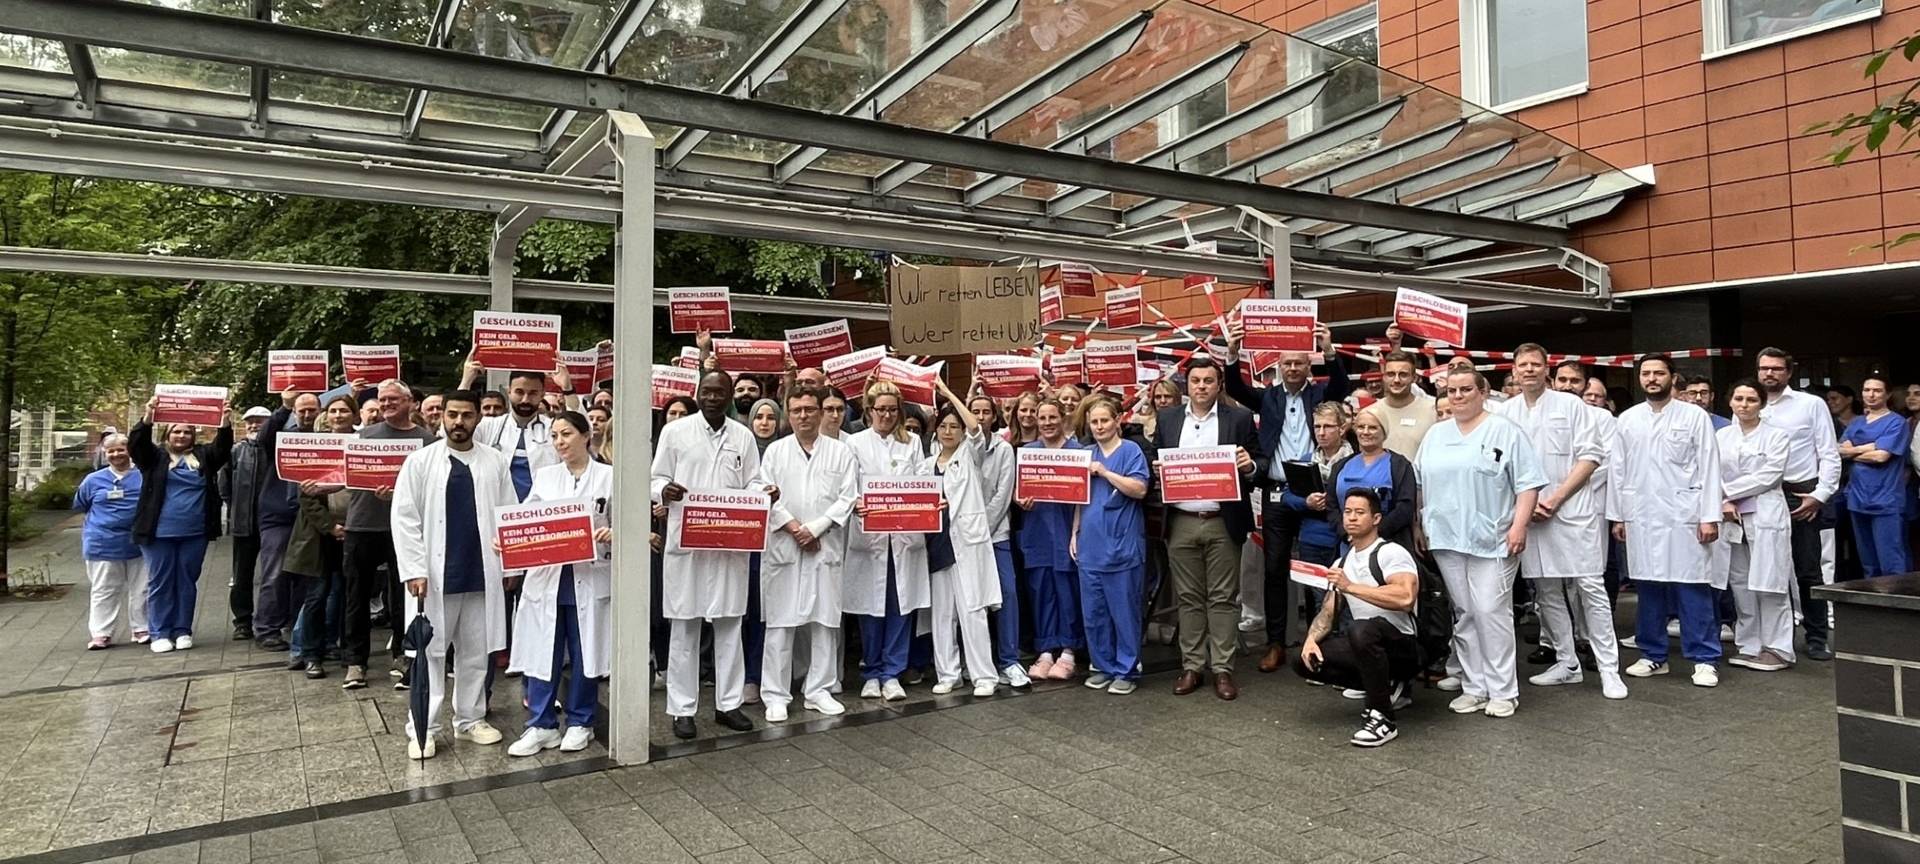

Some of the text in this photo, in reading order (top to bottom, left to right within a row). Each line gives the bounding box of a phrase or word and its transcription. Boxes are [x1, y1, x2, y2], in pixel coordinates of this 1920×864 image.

[898, 272, 931, 306] Wir
[938, 281, 983, 303] retten
[985, 275, 1036, 299] LEBEN
[1246, 305, 1312, 313] GESCHLOSSEN!
[480, 317, 554, 329] GESCHLOSSEN!
[789, 324, 845, 341] GESCHLOSSEN!
[902, 321, 953, 345] Wer
[962, 322, 1005, 342] rettet
[563, 355, 594, 363] LOSSEN!
[281, 437, 344, 446] GESCHLOSSE
[347, 443, 417, 452] GESCHLOSSEN!
[1022, 453, 1086, 463] GESCHLOSSEN!
[1163, 451, 1232, 462] GESCHLOSSEN!
[867, 481, 937, 489] GESCHLOSSEN!
[688, 494, 765, 506] GESCHLOSSEN!
[501, 503, 585, 521] GESCHLOSSEN!
[710, 519, 762, 528] VERSORGUNG.
[523, 526, 548, 535] GELD.
[503, 528, 587, 545] KEINE VERSORGUNG.
